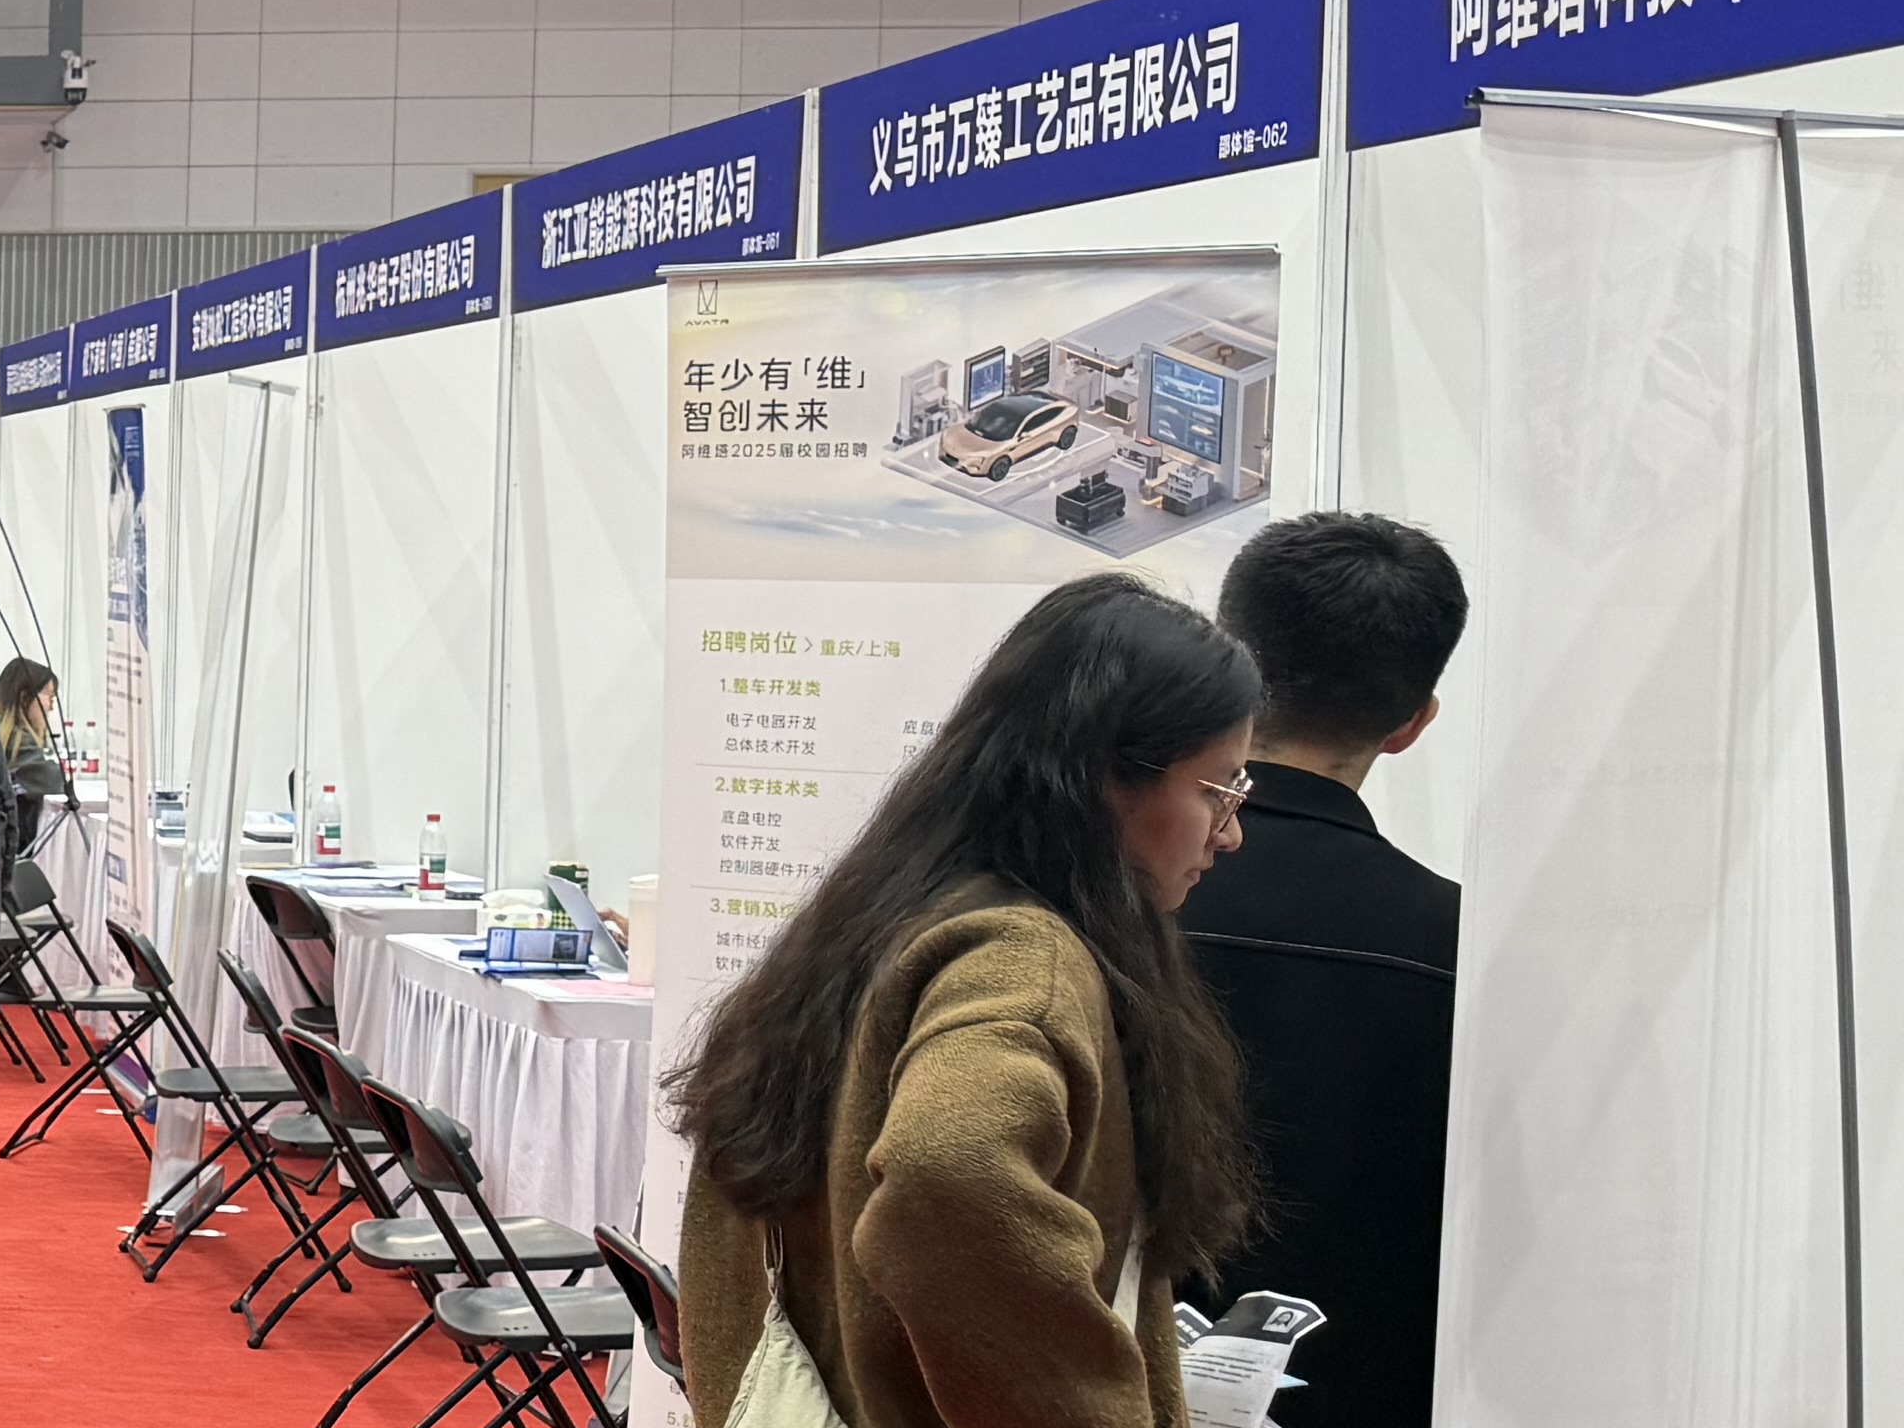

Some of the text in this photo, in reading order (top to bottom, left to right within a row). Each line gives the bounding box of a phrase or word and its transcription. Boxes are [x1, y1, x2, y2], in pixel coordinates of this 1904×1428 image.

[868, 21, 1240, 197] 义乌市万臻工艺品有限公司
[541, 155, 756, 270] 浙江亚能能源科技有限公司
[683, 399, 829, 433] 智创未来
[681, 441, 868, 460] 阿维塔2025届校园招聘
[701, 629, 901, 658] 招聘岗位 重庆/上海
[725, 738, 816, 756] 总体技术开发
[715, 777, 819, 798] 2.数字技术类
[721, 810, 782, 828] 底盘电控
[721, 834, 780, 852] 软件开发
